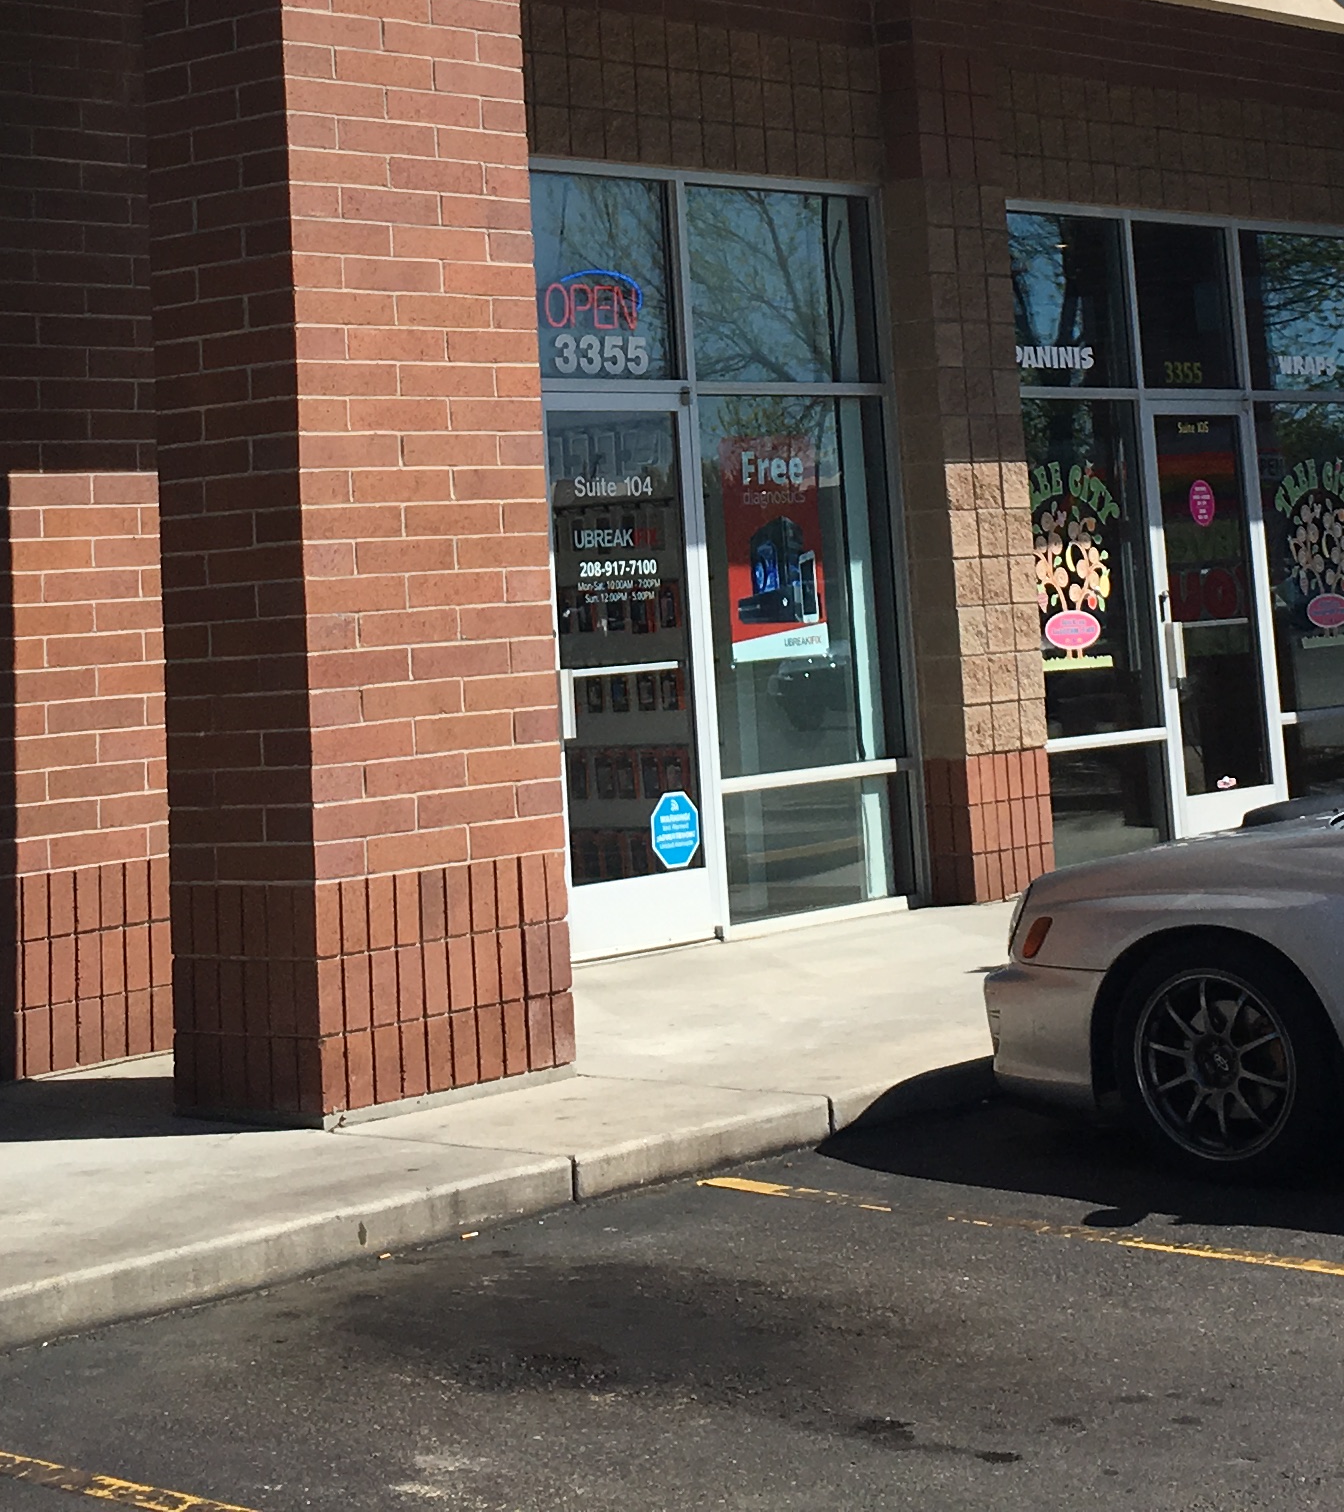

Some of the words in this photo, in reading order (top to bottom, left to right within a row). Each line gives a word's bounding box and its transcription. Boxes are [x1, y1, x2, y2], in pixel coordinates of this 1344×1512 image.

[544, 282, 640, 331] OPEN
[554, 333, 649, 375] 3355
[1277, 355, 1337, 376] WRAPS
[1163, 360, 1203, 384] 3355
[741, 451, 804, 485] Free
[574, 475, 617, 498] Suite
[623, 475, 654, 497] 104
[743, 488, 806, 509] diagnostics
[1274, 458, 1319, 519] TREE
[579, 559, 657, 578] 208-917-7100
